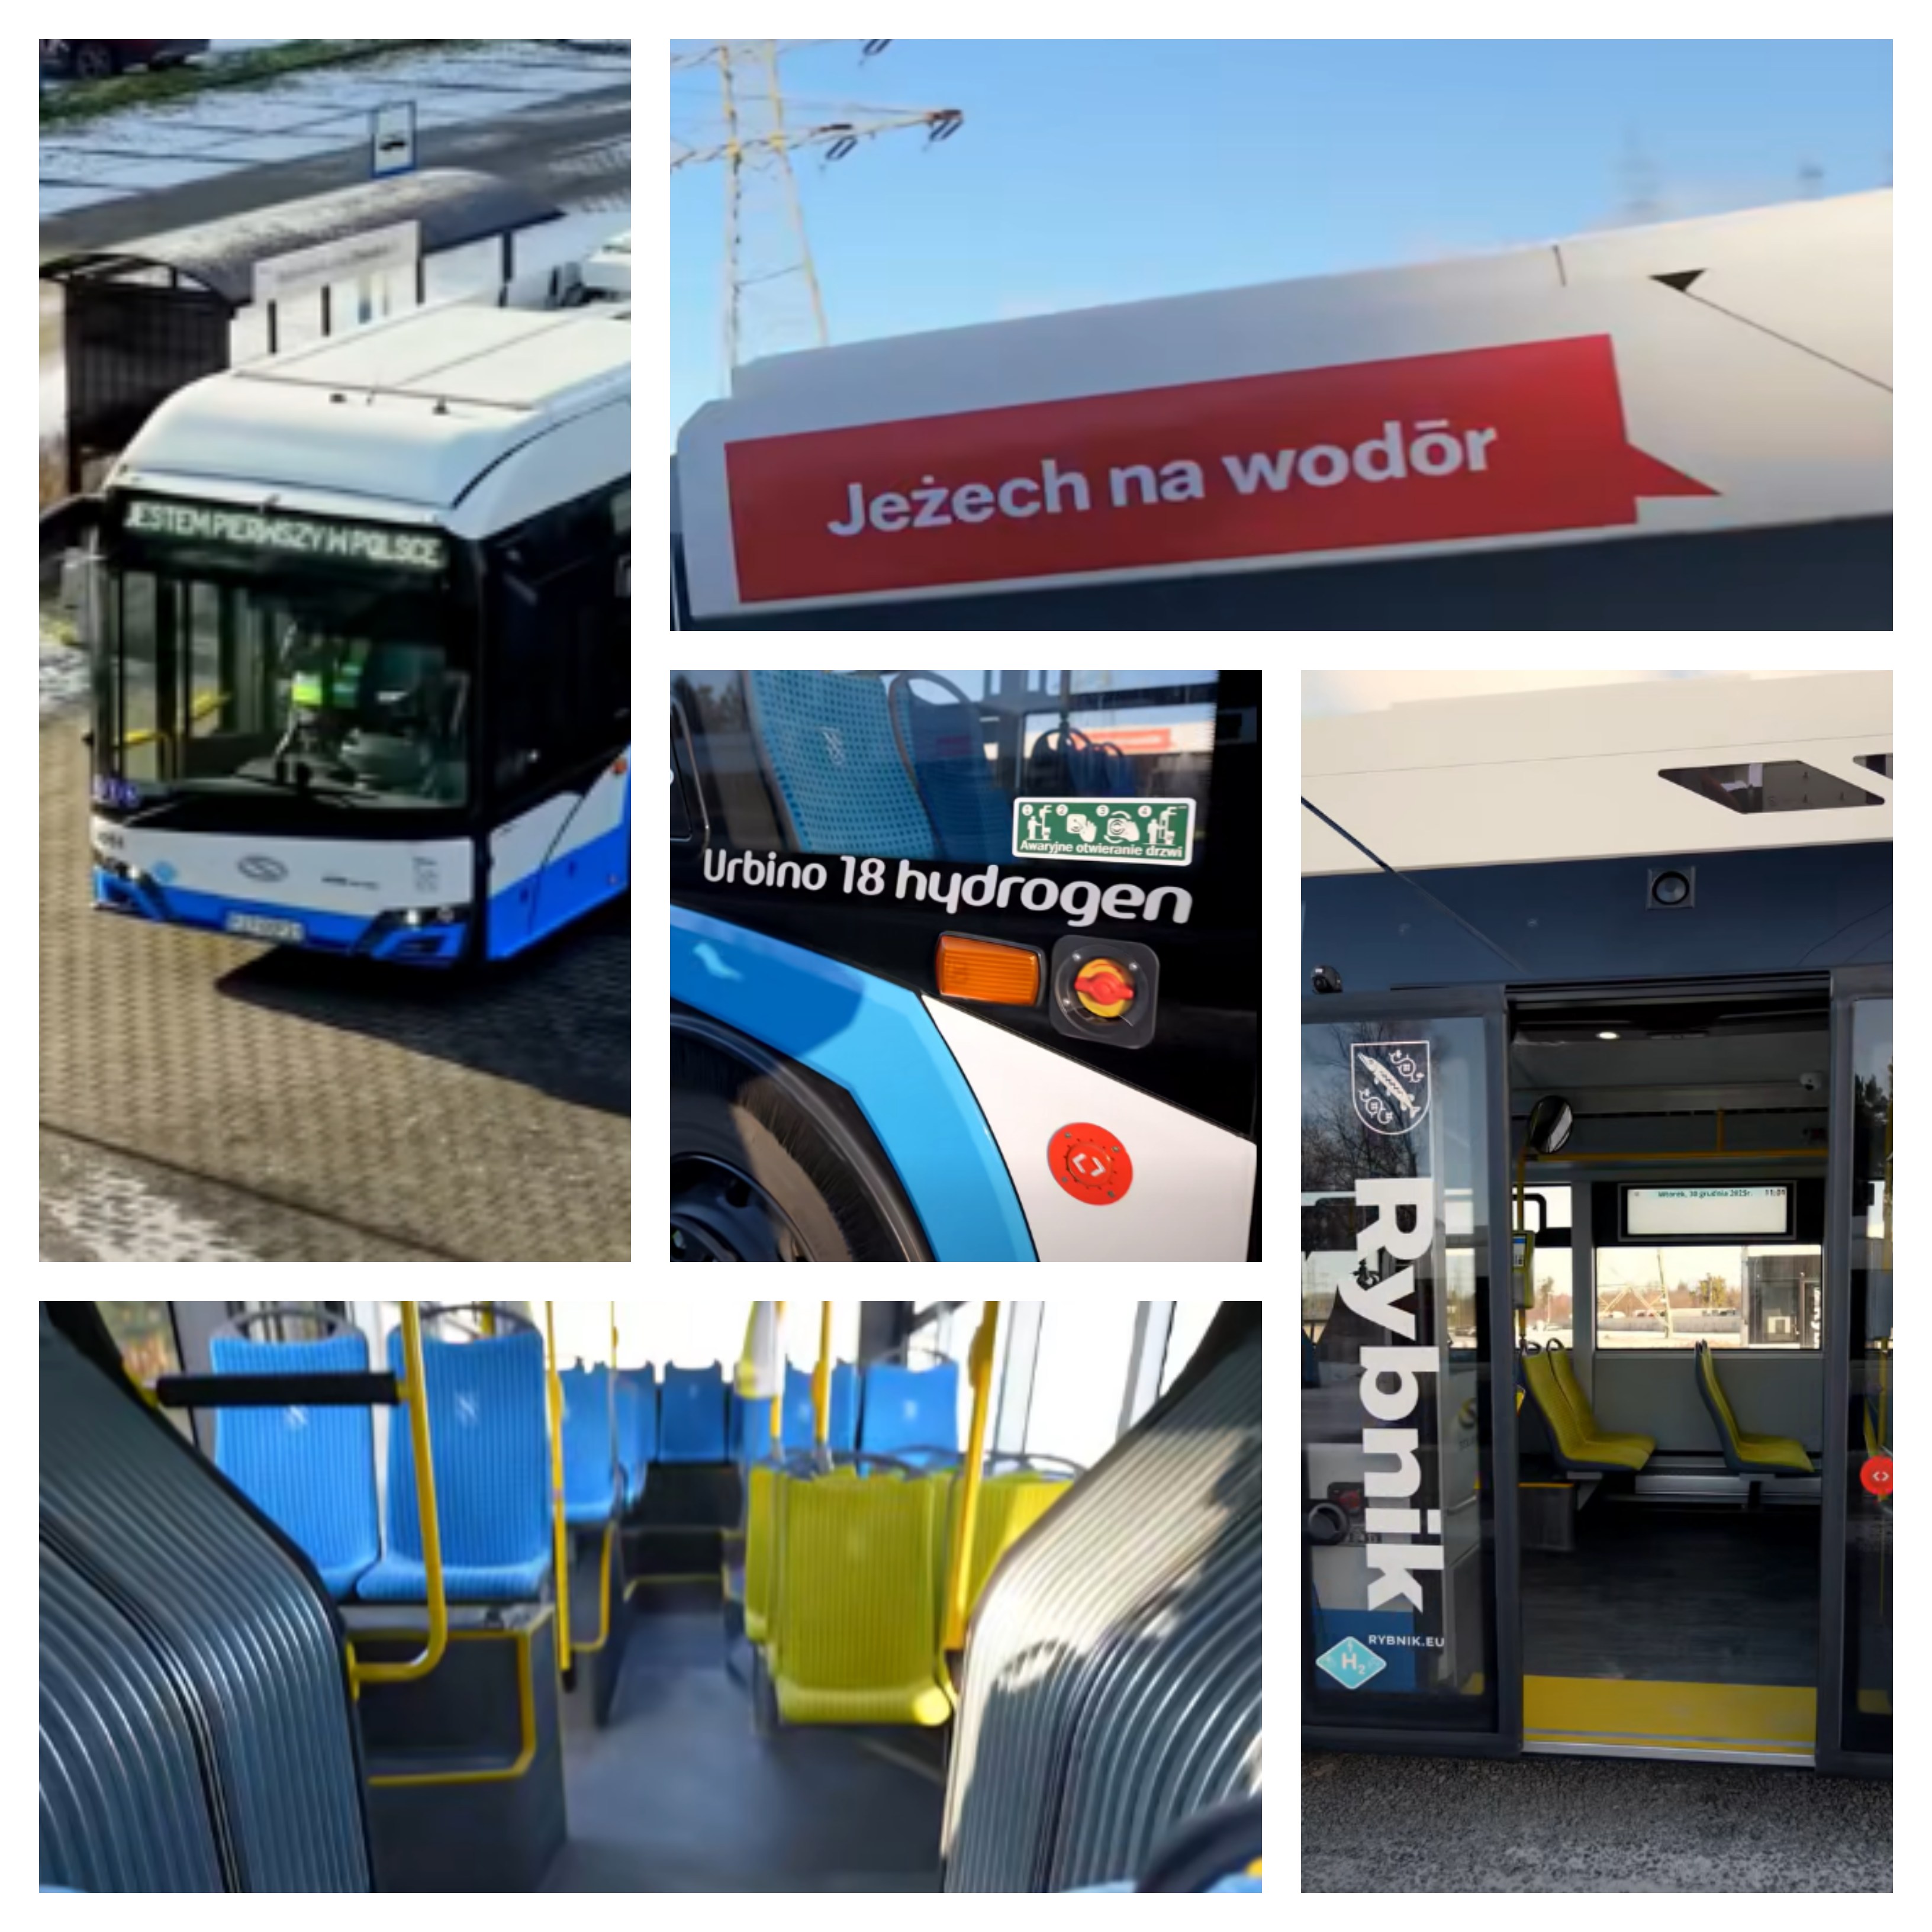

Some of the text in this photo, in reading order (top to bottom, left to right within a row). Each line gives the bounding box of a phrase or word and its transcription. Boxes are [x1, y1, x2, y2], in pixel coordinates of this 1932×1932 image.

[122, 500, 211, 537] JESTEM
[213, 510, 325, 551] PIERWSZY
[350, 528, 443, 568] POLSCE
[827, 458, 1090, 537] Jeżech
[1109, 459, 1205, 507] na
[1020, 840, 1183, 857] Awaryjne otwieranie drzwi
[703, 848, 1193, 928] Urbino 18 hydrogen
[1336, 1177, 1445, 1614] Rybnik
[1368, 1634, 1445, 1647] RYBNIK.EU
